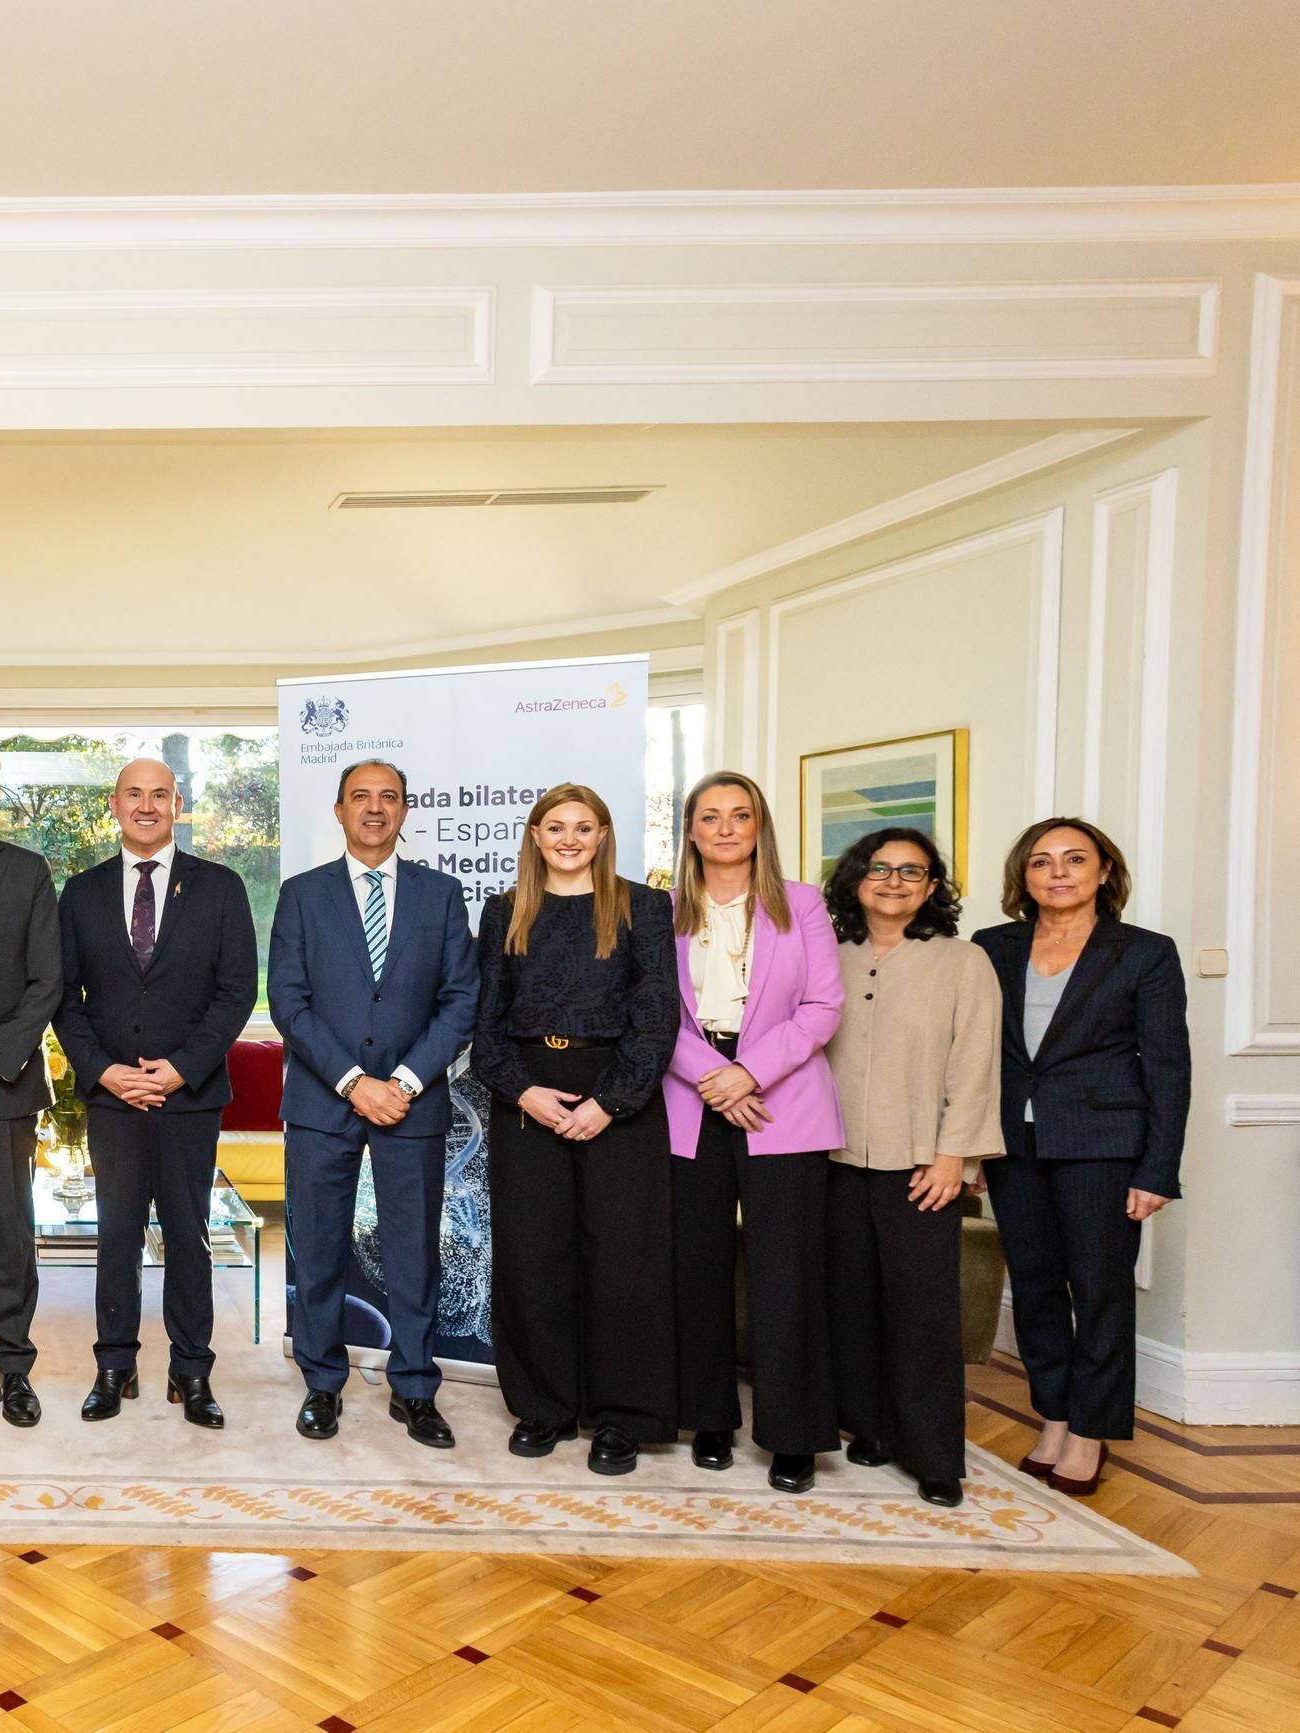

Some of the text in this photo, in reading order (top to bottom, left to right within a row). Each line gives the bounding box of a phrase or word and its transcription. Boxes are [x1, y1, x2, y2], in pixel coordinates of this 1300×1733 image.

[515, 698, 607, 713] AstraZeneca
[300, 738, 404, 753] Embajada Británica
[300, 753, 337, 764] Madrid
[406, 784, 548, 809] ada bilater
[437, 816, 526, 847] Españ
[438, 852, 521, 874] Medici
[463, 881, 517, 903] cisi
